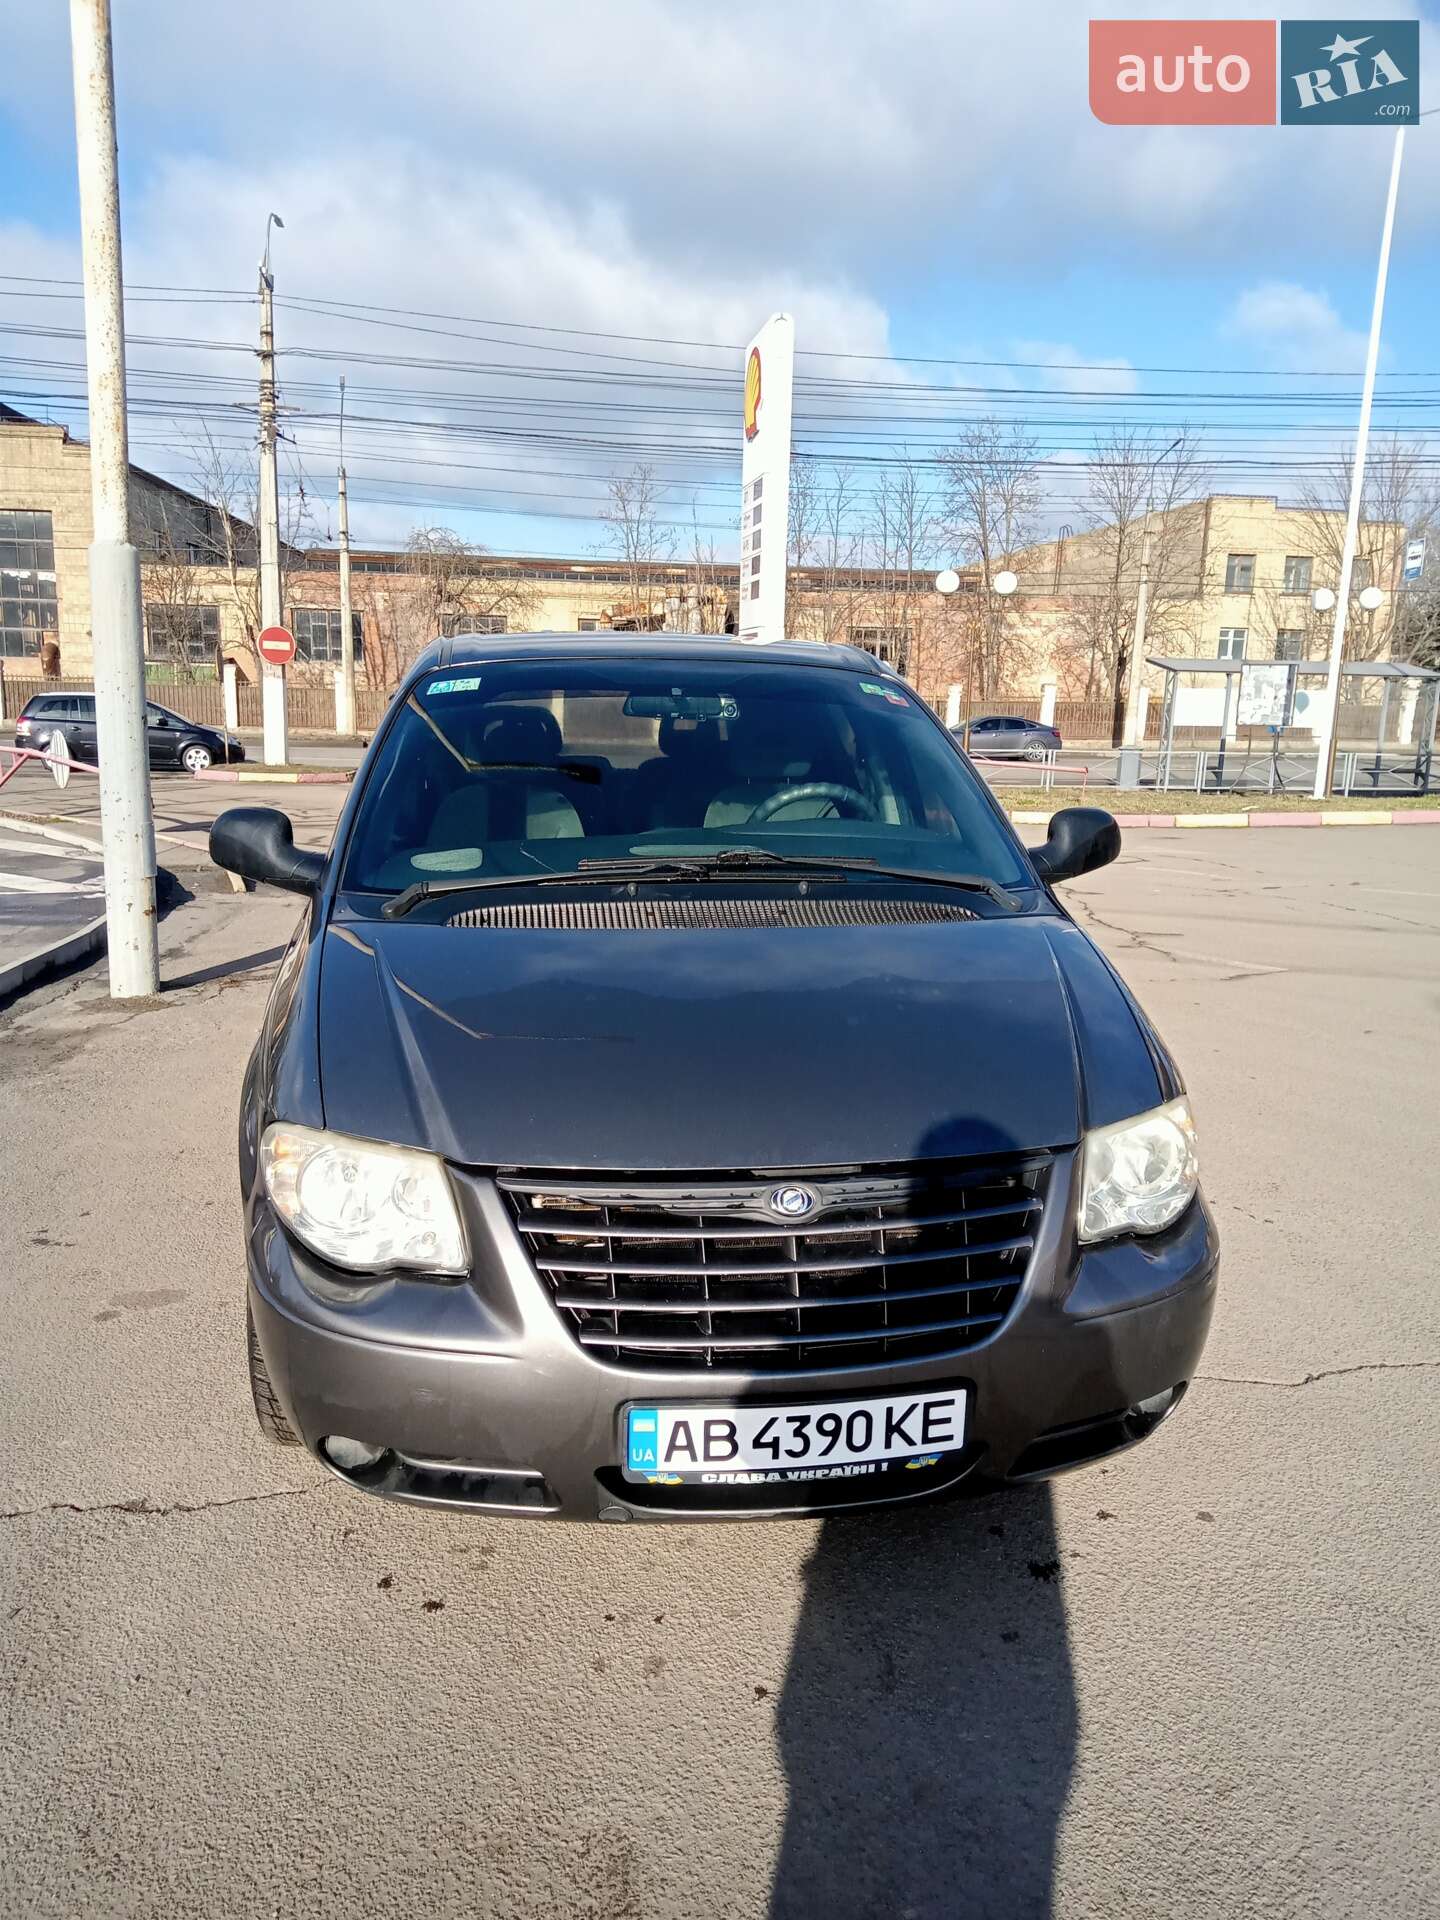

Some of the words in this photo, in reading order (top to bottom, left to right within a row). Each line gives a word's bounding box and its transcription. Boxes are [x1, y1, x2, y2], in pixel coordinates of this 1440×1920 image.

[664, 1419, 739, 1462] AB
[752, 1409, 873, 1460] 4390
[884, 1398, 956, 1449] KE
[632, 1447, 655, 1462] UA
[701, 1472, 781, 1484] СЛАВА
